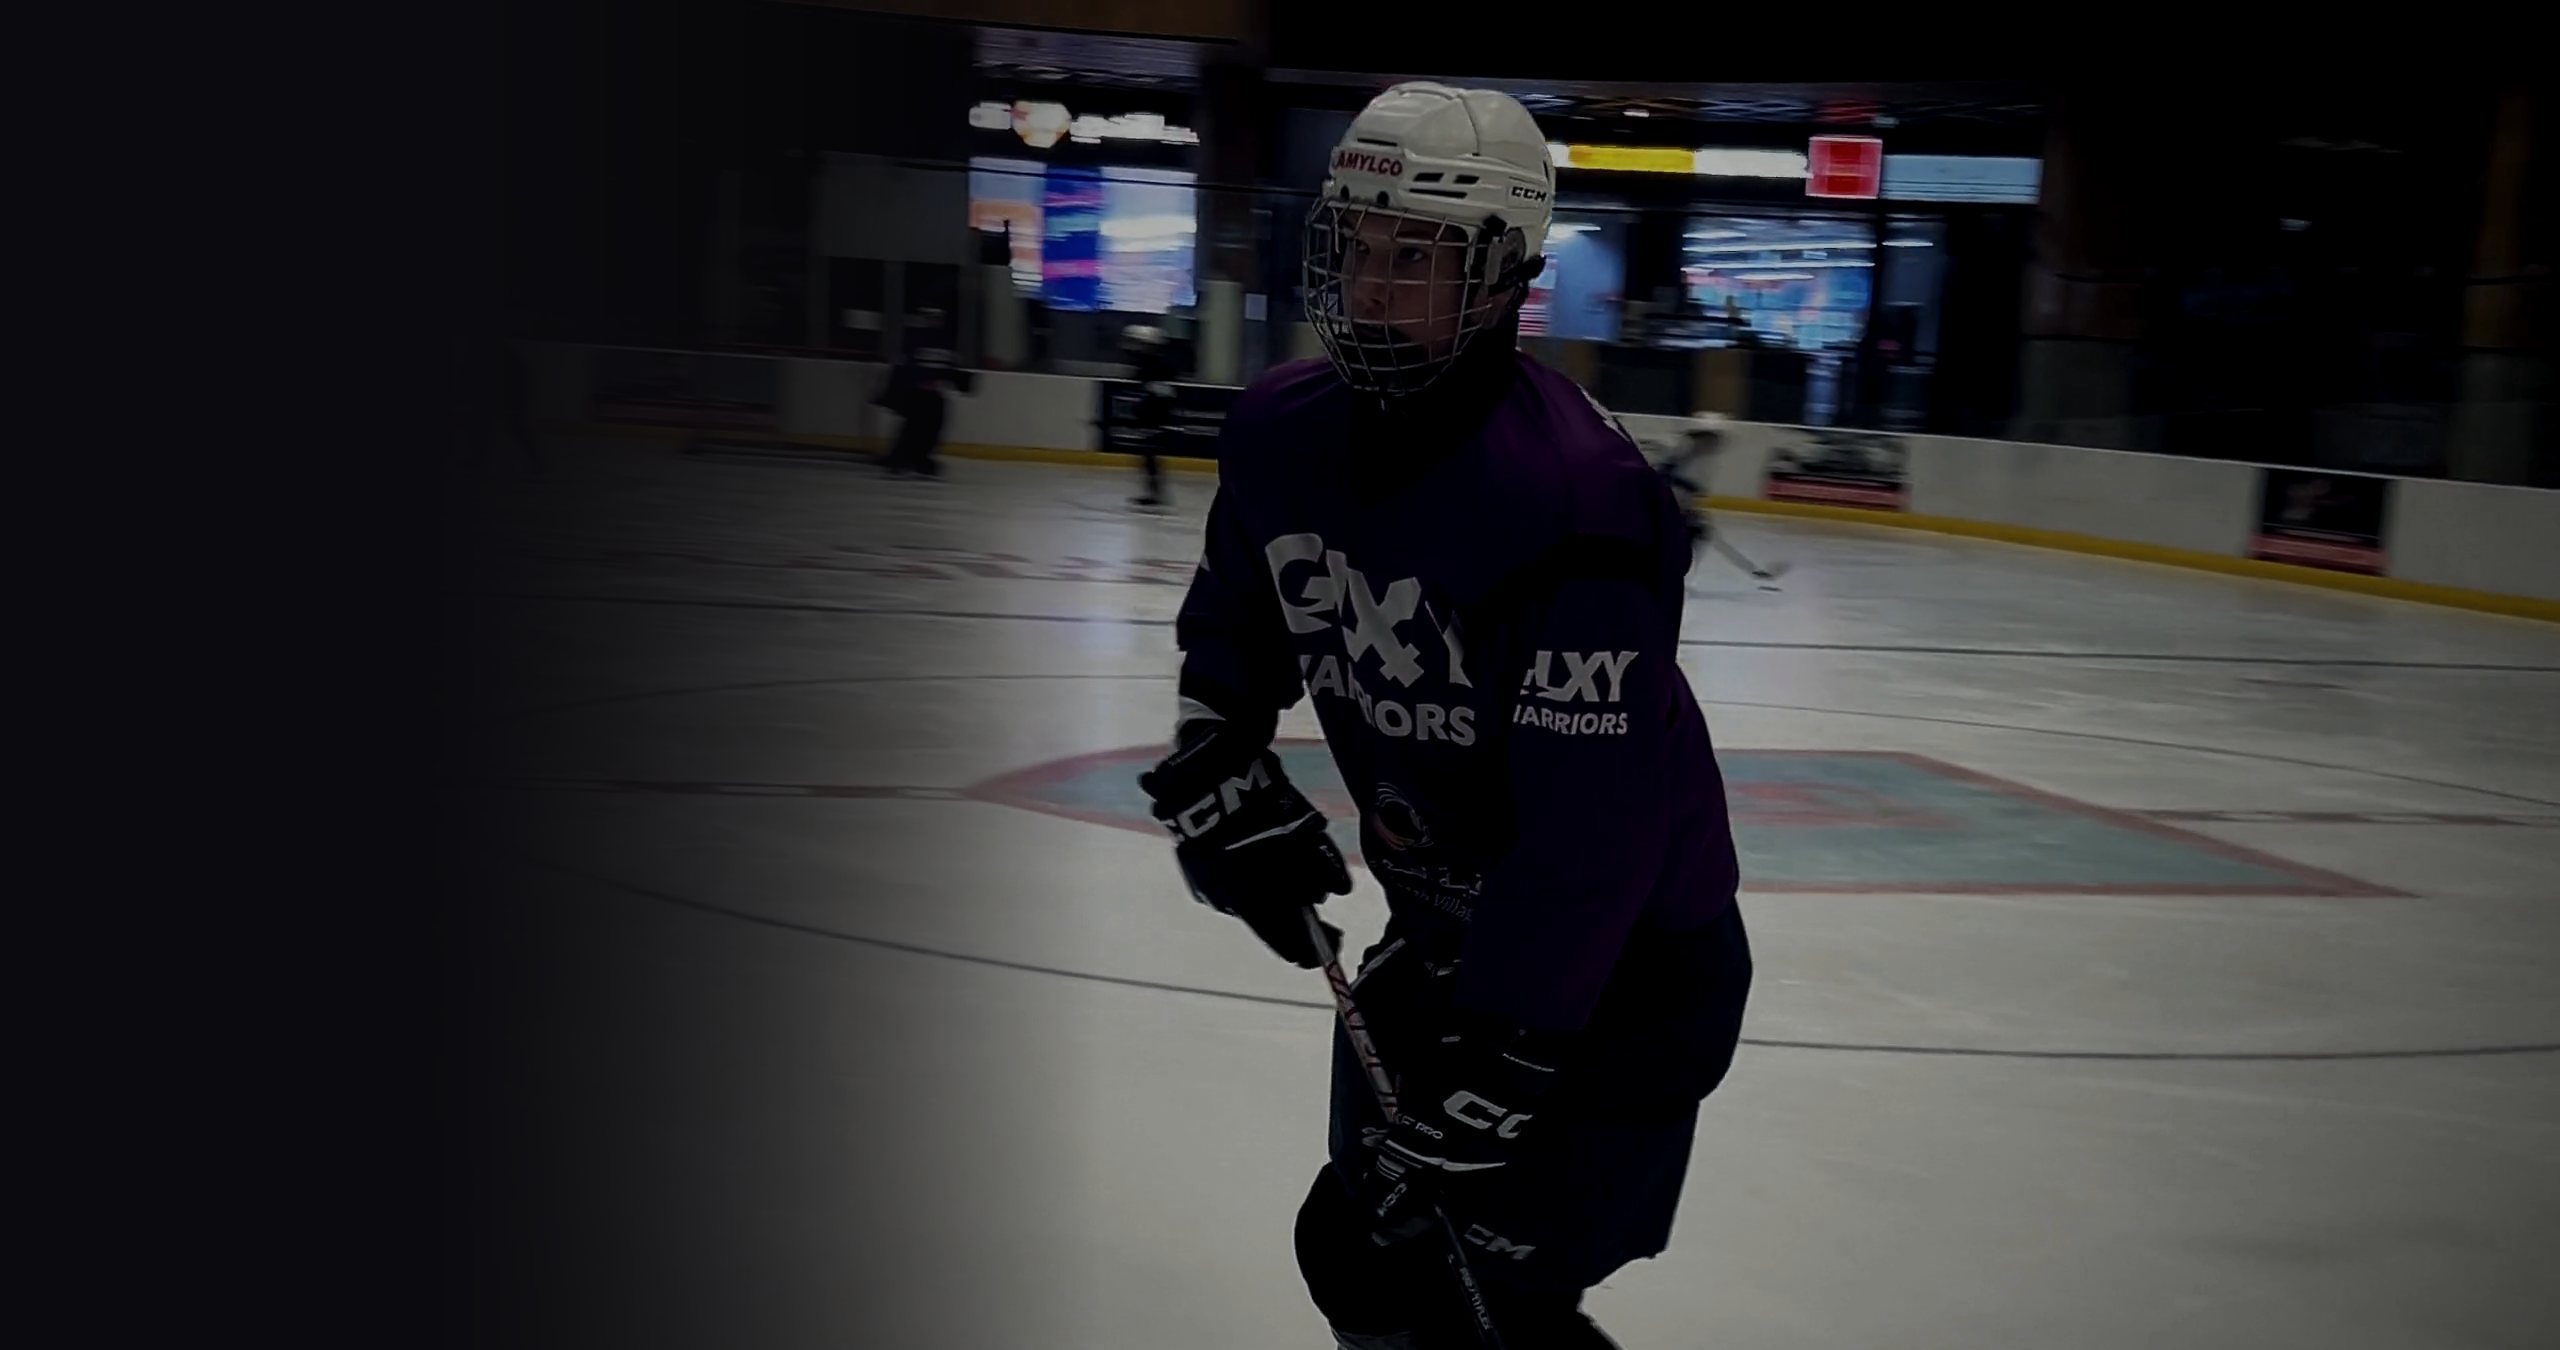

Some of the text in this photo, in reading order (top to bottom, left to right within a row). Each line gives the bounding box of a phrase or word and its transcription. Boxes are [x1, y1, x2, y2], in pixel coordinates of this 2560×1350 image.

[1512, 186, 1547, 201] CCM
[1164, 757, 1273, 840] CM
[1443, 1090, 1534, 1140] CC
[1464, 1223, 1537, 1261] CM
